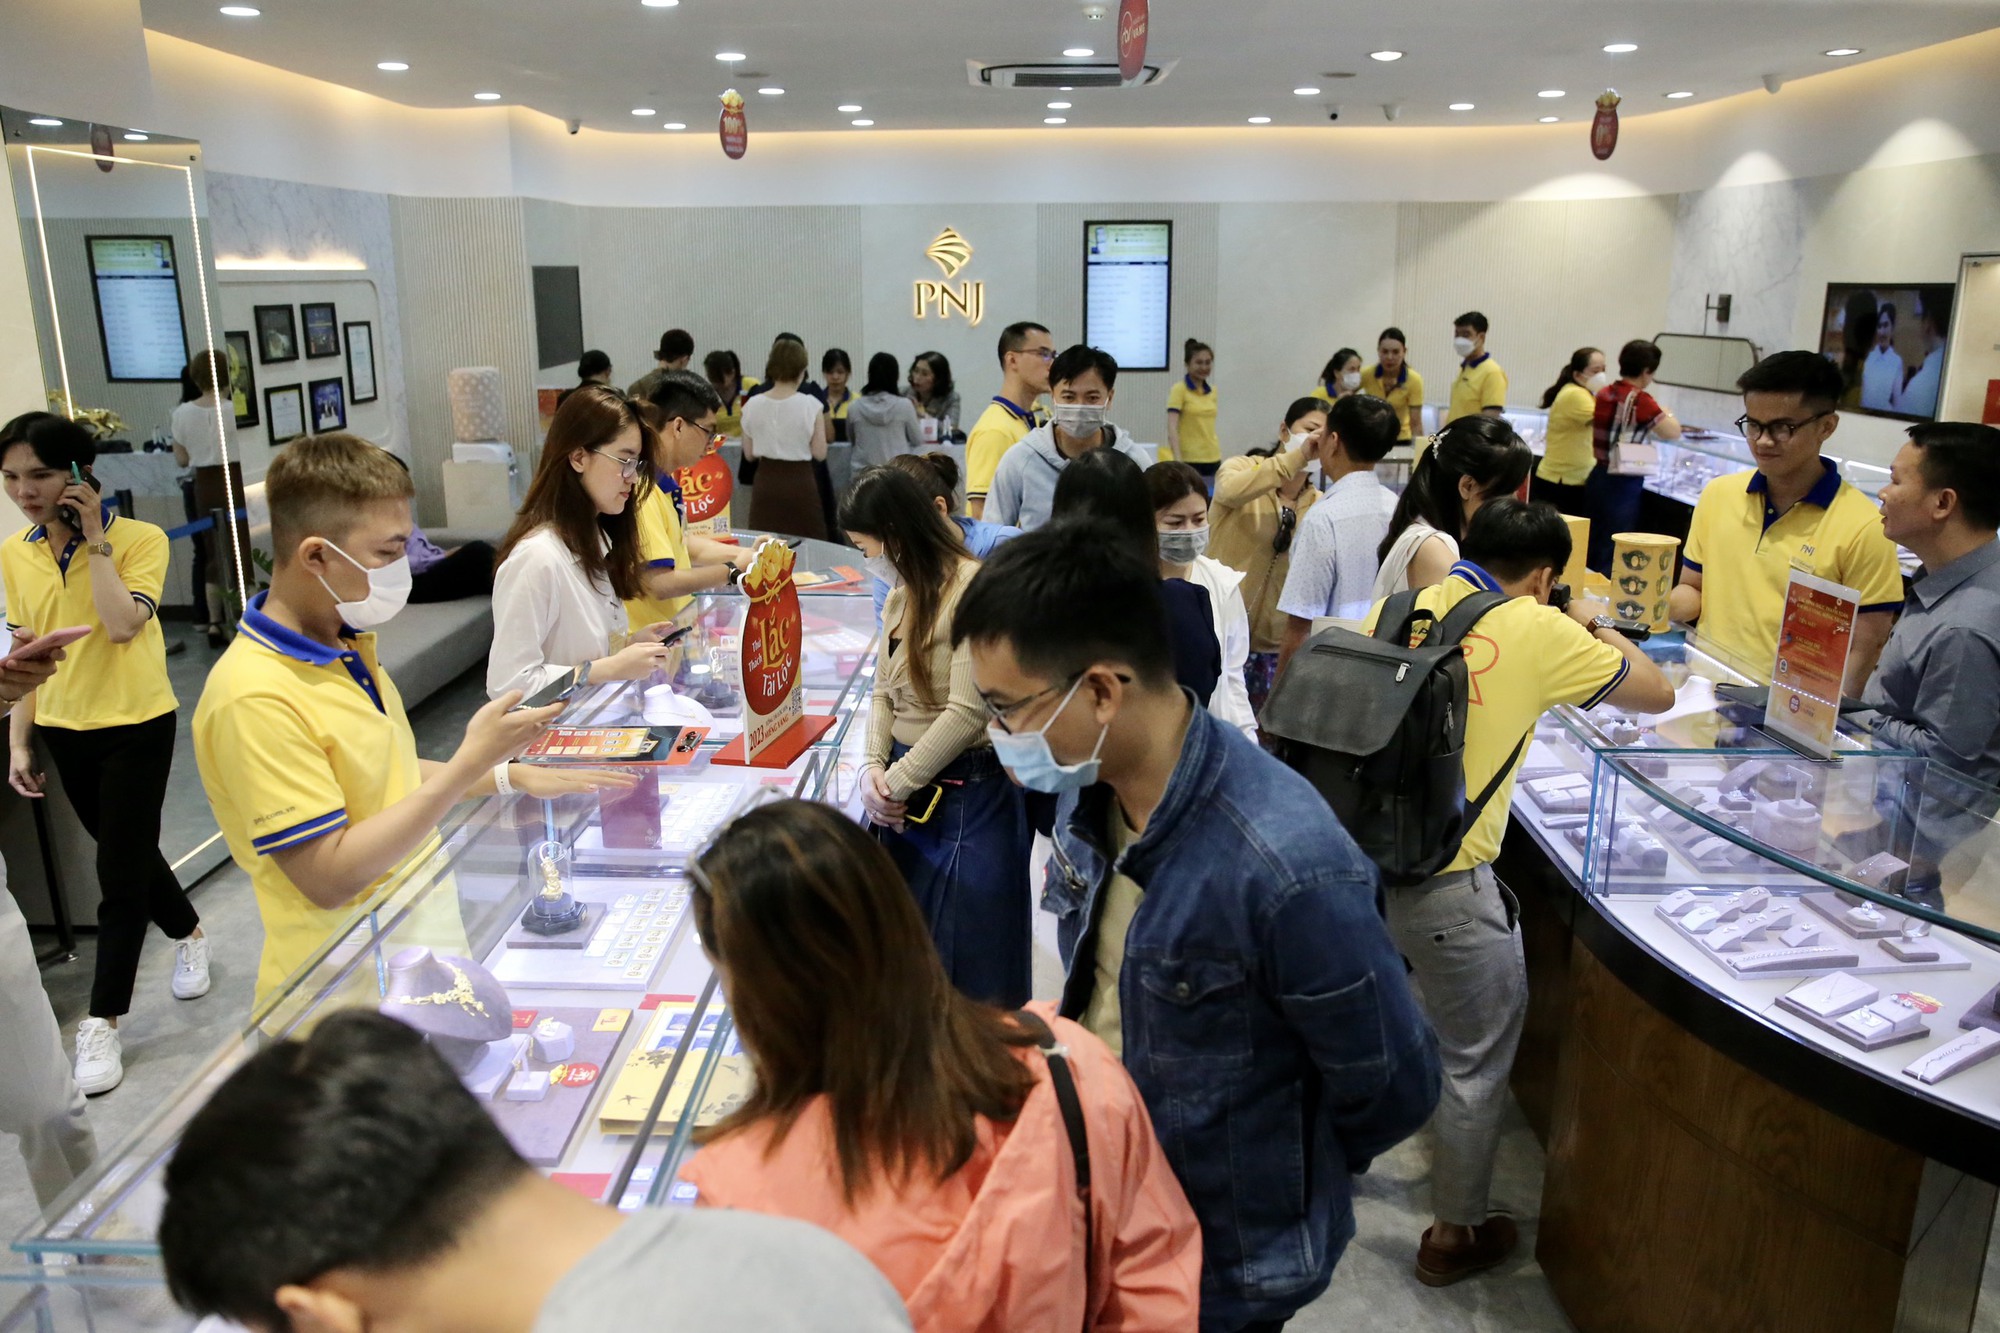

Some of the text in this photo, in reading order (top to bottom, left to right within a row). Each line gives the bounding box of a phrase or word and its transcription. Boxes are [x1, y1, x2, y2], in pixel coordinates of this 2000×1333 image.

[914, 280, 984, 327] PNJ
[691, 494, 715, 515] Lộc
[1800, 544, 1815, 557] PNJ
[763, 652, 792, 697] Tài Lộc
[749, 724, 764, 751] 2023
